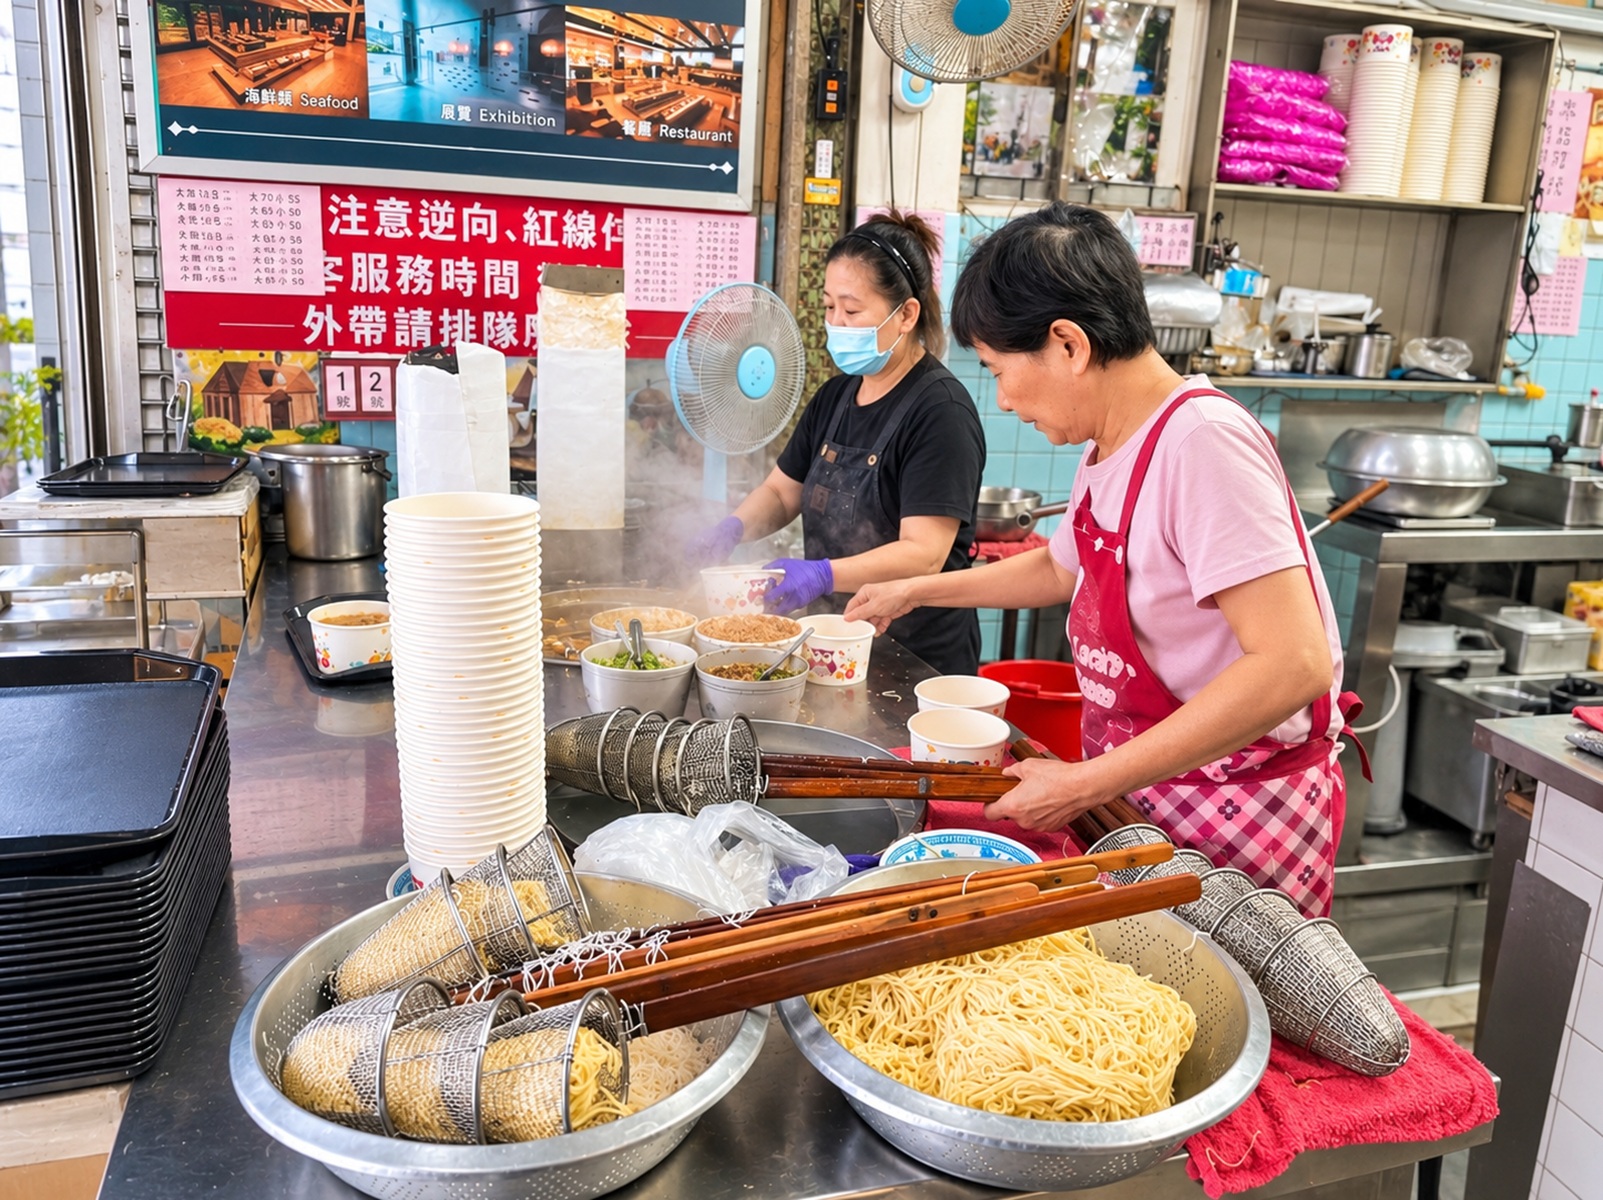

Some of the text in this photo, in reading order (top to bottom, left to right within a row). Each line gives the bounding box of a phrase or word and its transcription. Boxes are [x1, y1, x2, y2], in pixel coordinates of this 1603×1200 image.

[300, 93, 358, 110] Seafood
[479, 109, 556, 127] Exhibition
[659, 124, 733, 143] Restaurant
[336, 371, 345, 391] 1
[369, 371, 382, 391] 2
